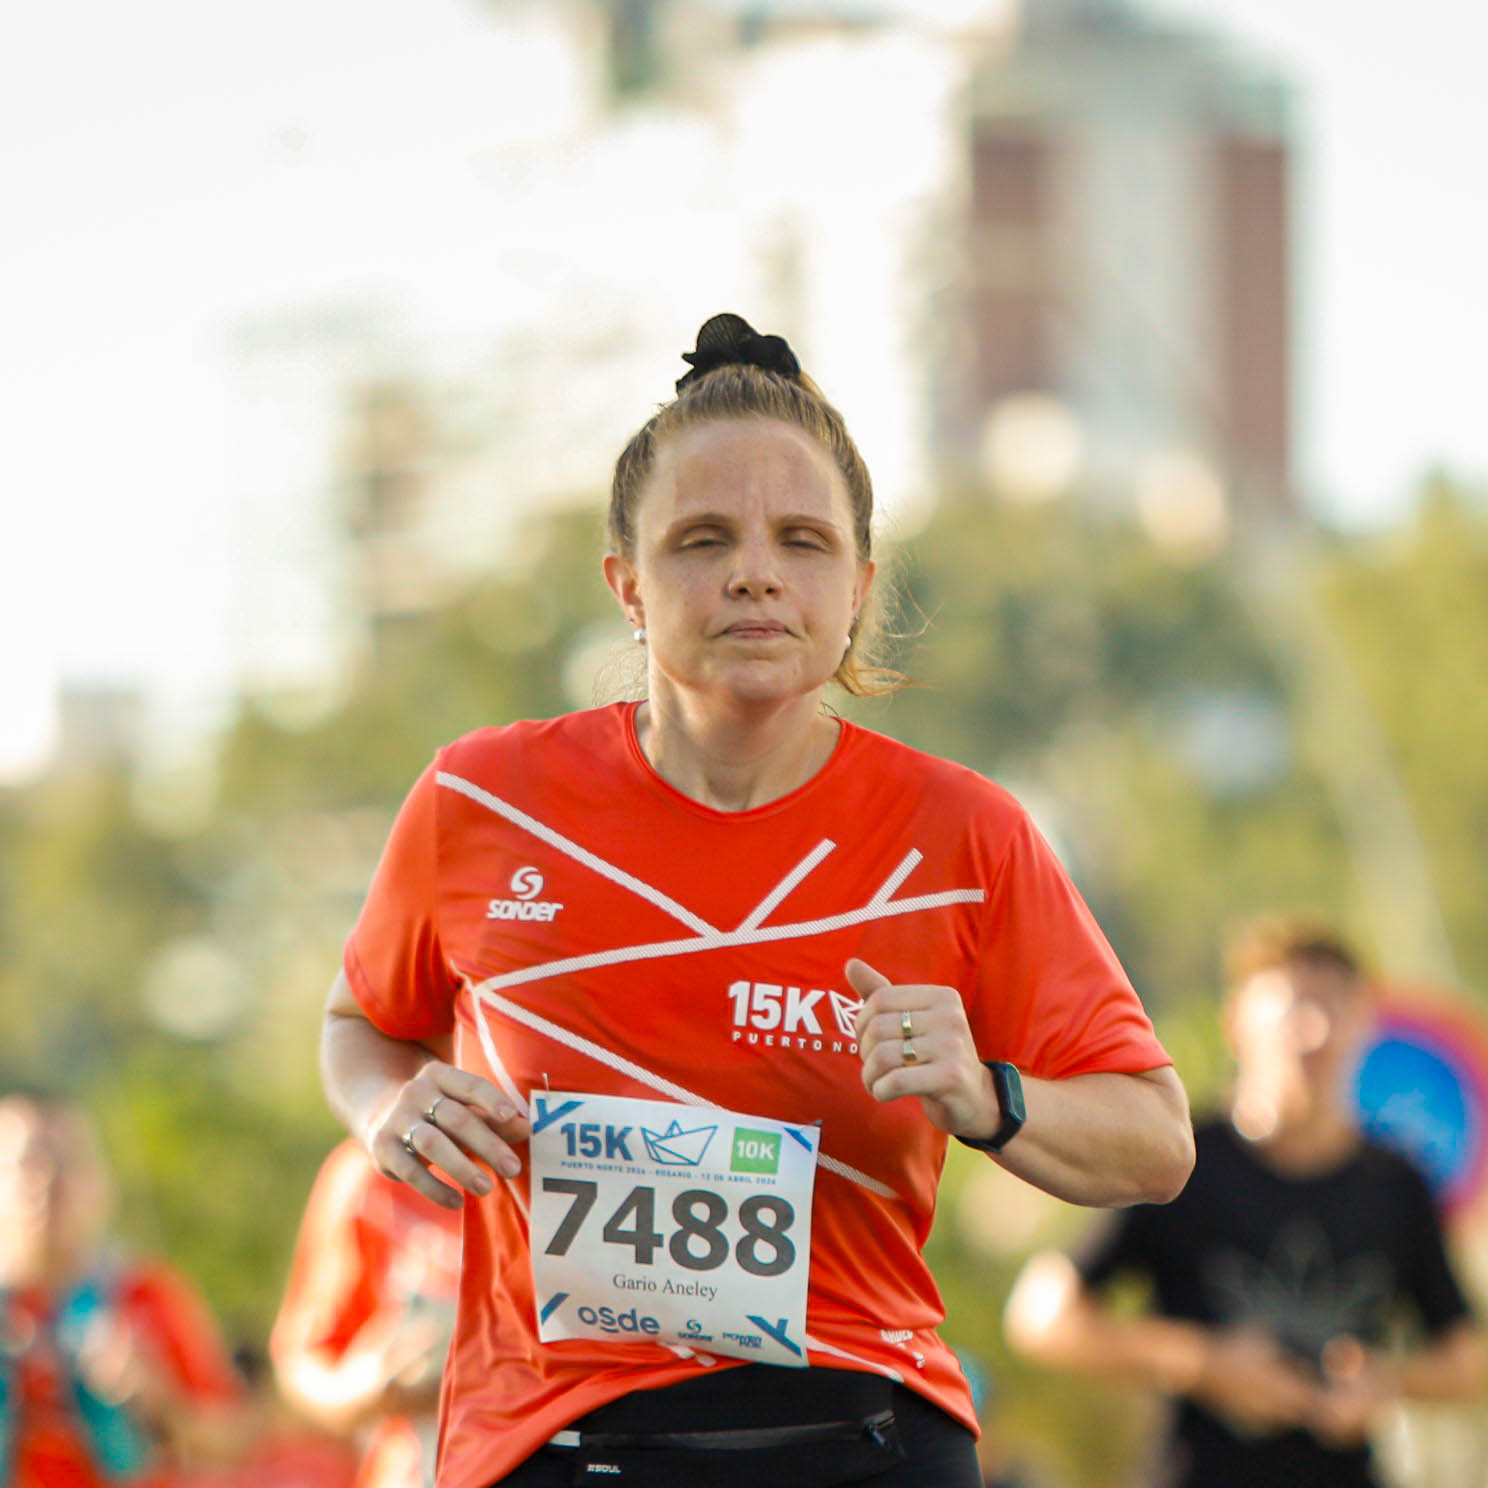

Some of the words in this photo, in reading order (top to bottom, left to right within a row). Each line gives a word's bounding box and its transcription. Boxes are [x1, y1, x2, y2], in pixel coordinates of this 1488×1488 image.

[728, 980, 827, 1035] 15K
[732, 1031, 823, 1051] PUERTO
[561, 1122, 633, 1161] 15K
[736, 1140, 775, 1161] 10K
[542, 1177, 796, 1277] 7488
[613, 1273, 657, 1292] Gario
[662, 1279, 718, 1302] Aneley
